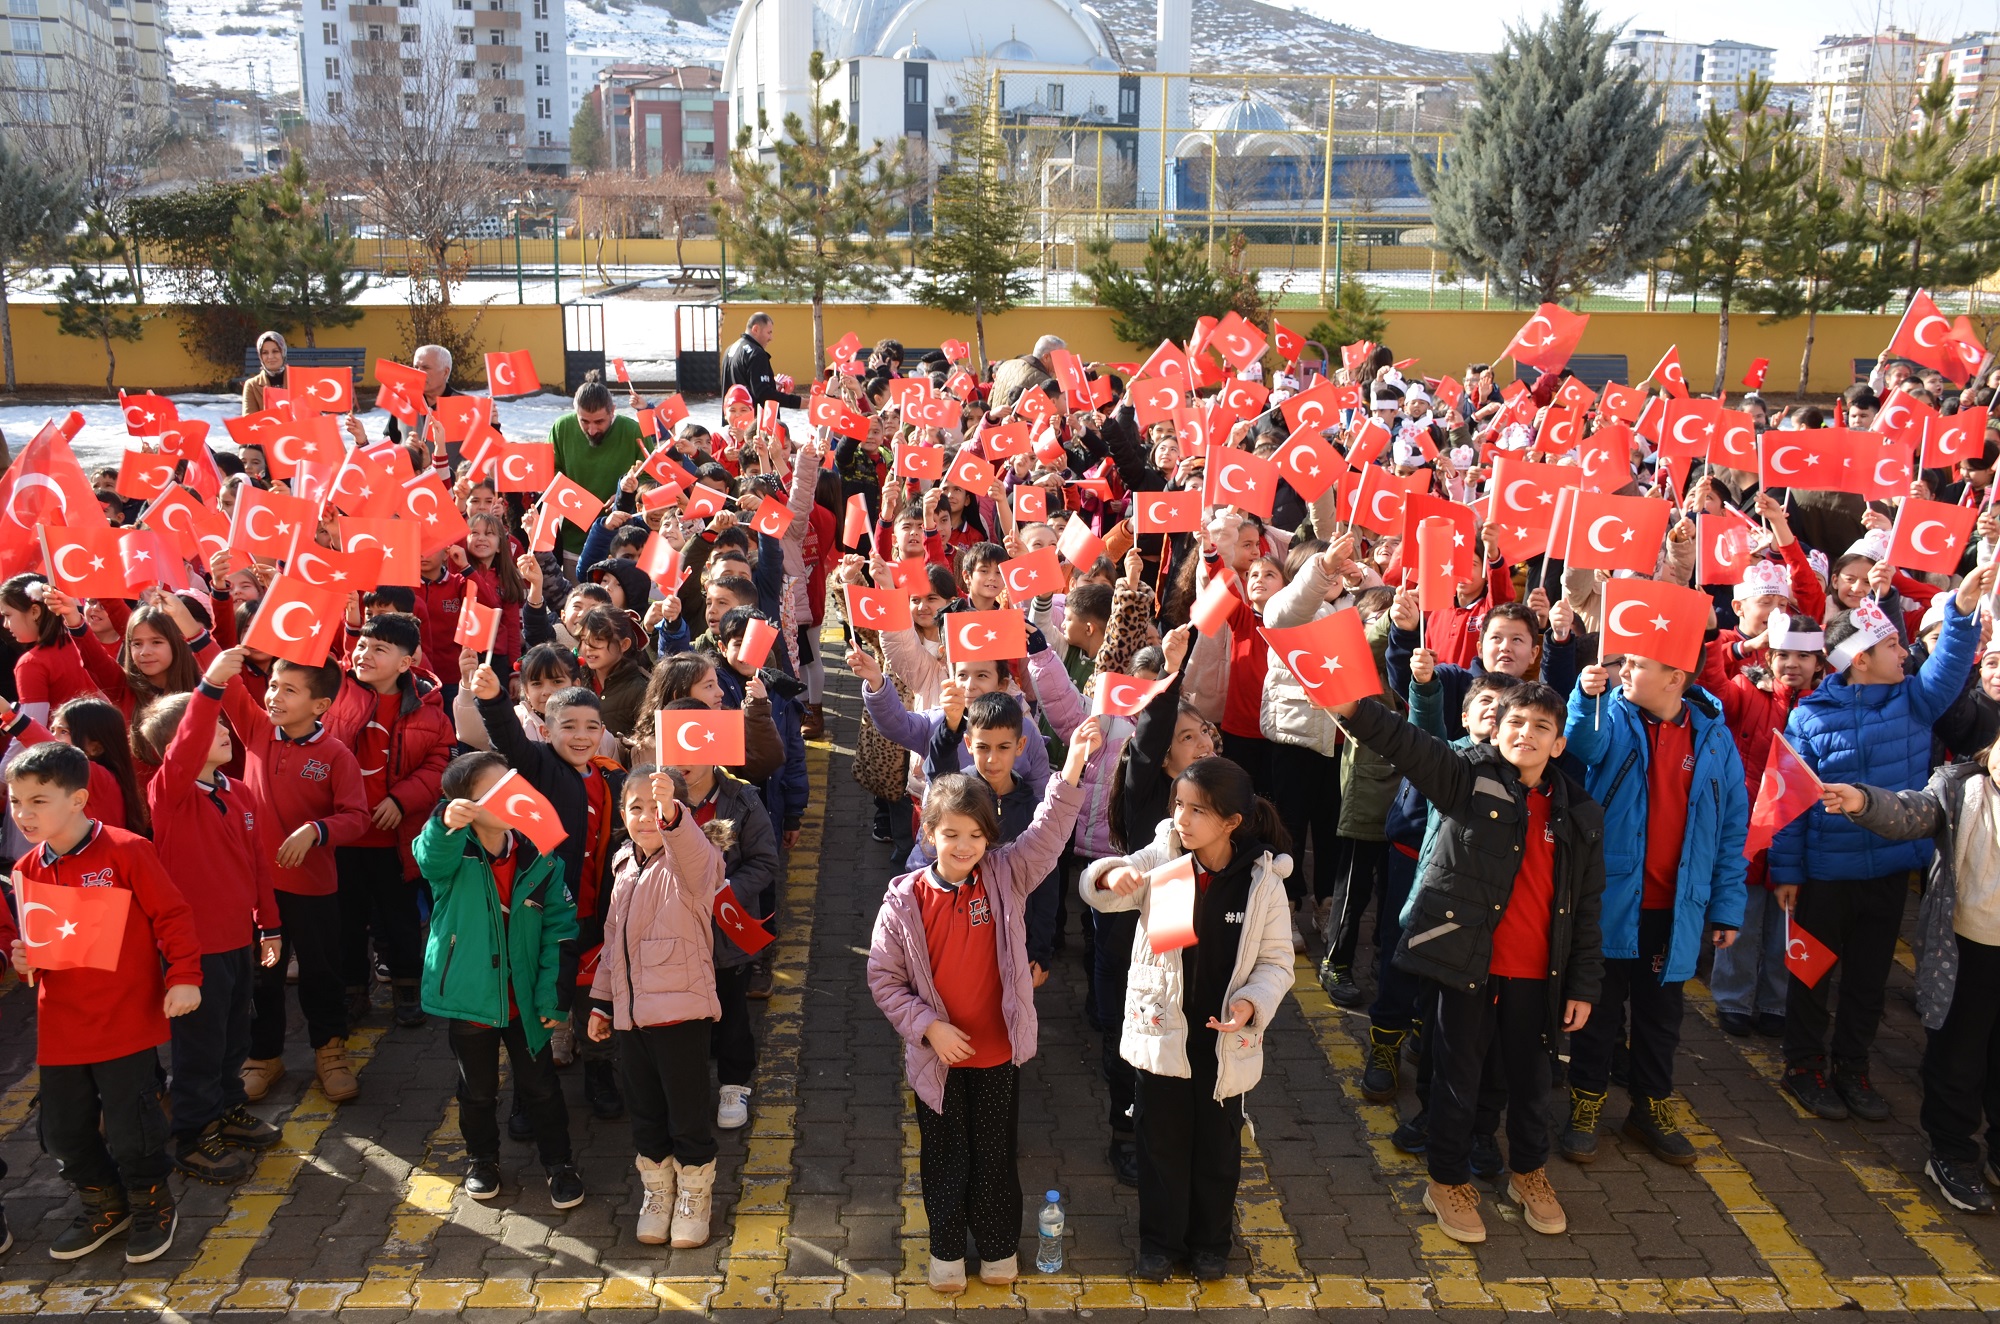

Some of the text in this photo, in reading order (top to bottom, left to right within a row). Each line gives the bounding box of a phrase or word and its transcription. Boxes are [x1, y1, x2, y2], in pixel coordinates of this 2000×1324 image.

[301, 759, 330, 782] EG
[1682, 755, 1694, 771] E
[969, 896, 990, 926] EG
